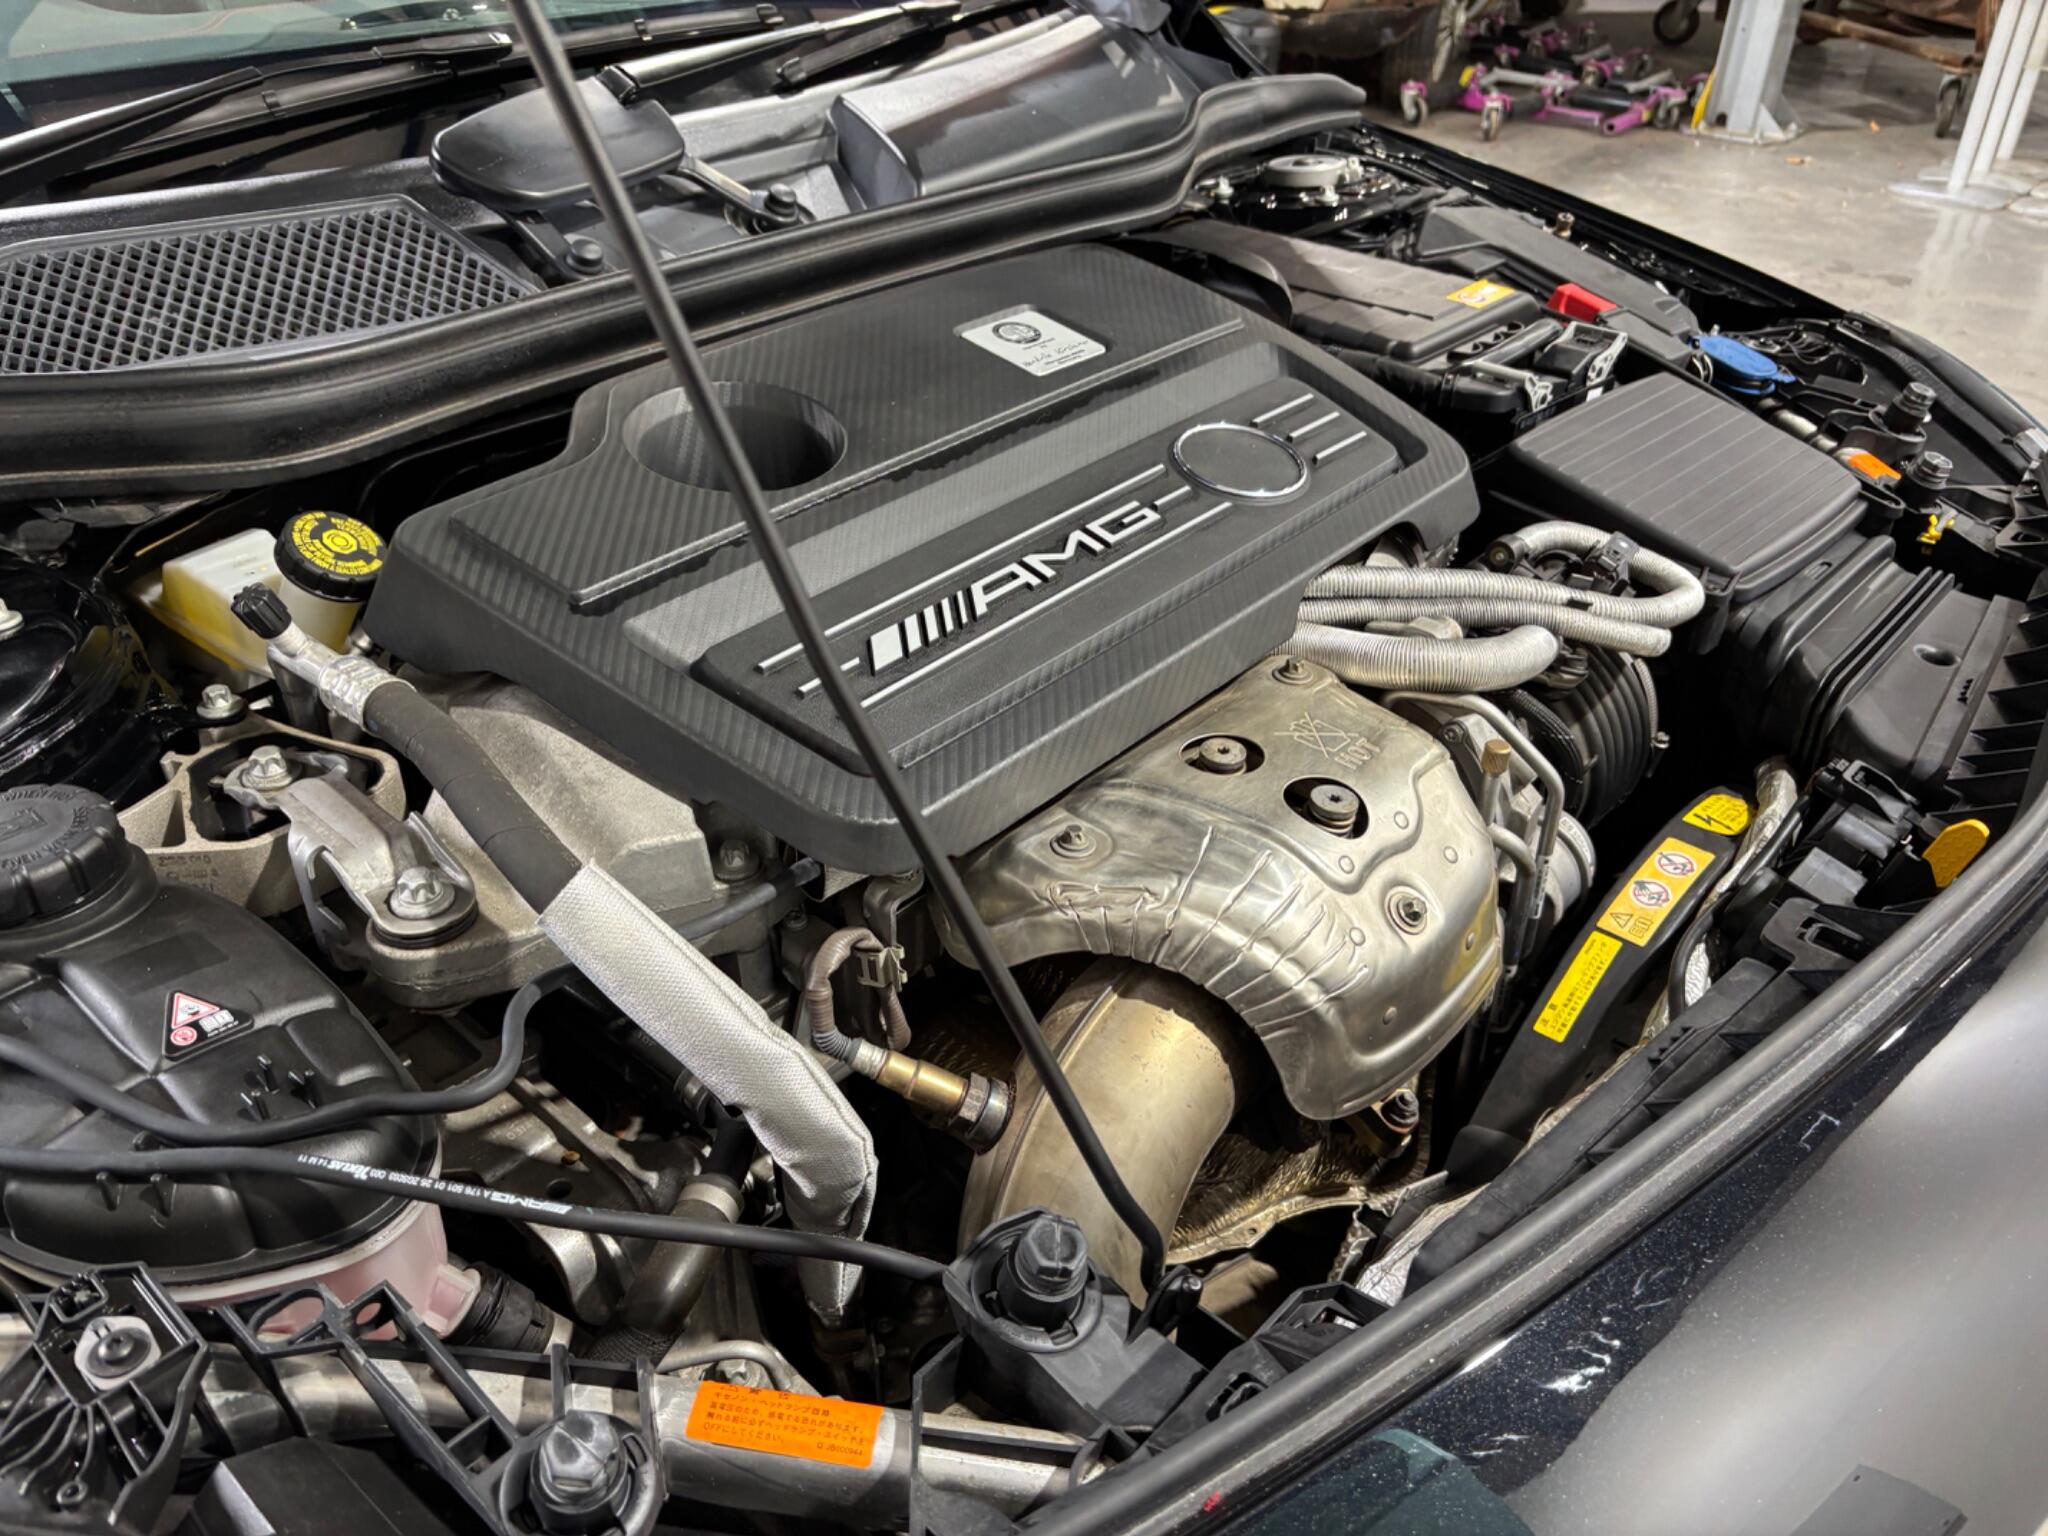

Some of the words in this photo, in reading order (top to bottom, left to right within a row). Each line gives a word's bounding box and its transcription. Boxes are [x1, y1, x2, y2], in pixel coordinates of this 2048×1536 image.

[970, 499, 1162, 617] AMG
[1334, 737, 1380, 770] HOT
[434, 1181, 446, 1190] 01
[483, 1189, 491, 1199] A
